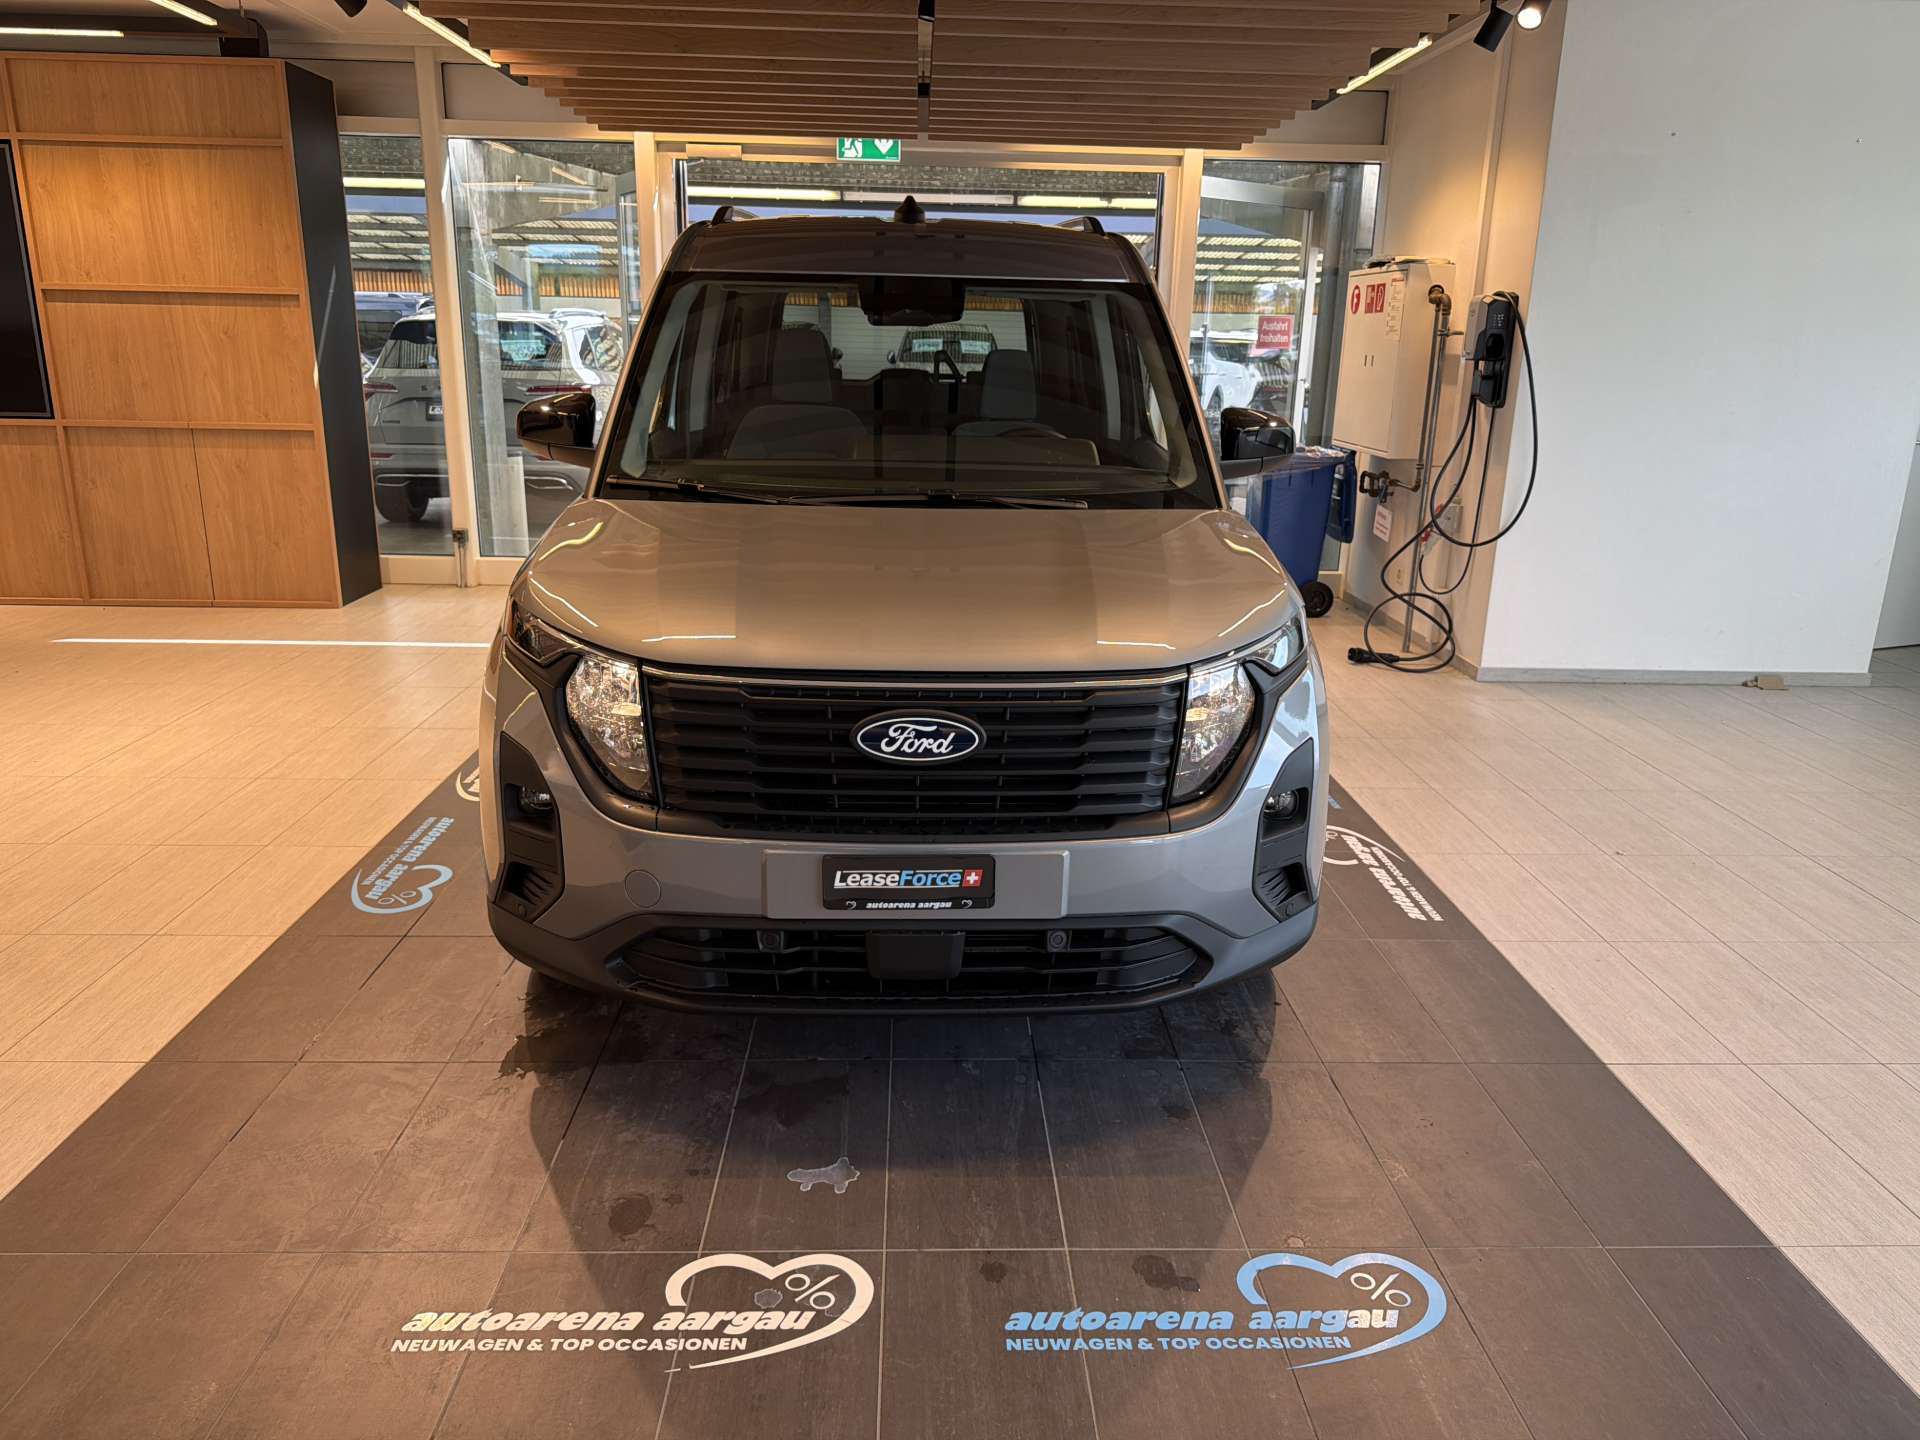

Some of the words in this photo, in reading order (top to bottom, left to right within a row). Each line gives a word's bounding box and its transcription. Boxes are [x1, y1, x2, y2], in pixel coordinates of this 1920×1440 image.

[880, 723, 956, 754] Ford
[834, 869, 962, 888] LeaseForce
[866, 901, 916, 909] autoarena
[917, 901, 953, 910] aargau
[401, 1307, 645, 1332] autoarena
[652, 1310, 817, 1335] aargau
[1004, 1307, 1234, 1331] autoarena
[1249, 1309, 1400, 1333] aargau
[390, 1338, 524, 1352] NEUWAGEN
[526, 1338, 544, 1351] &
[549, 1338, 595, 1351] TOP
[597, 1337, 748, 1351] OCCASIONEN
[1005, 1338, 1133, 1351] NEUWAGEN
[1137, 1338, 1155, 1350] &
[1157, 1337, 1201, 1350] TOP
[1205, 1336, 1352, 1350] OCCASIONEN
